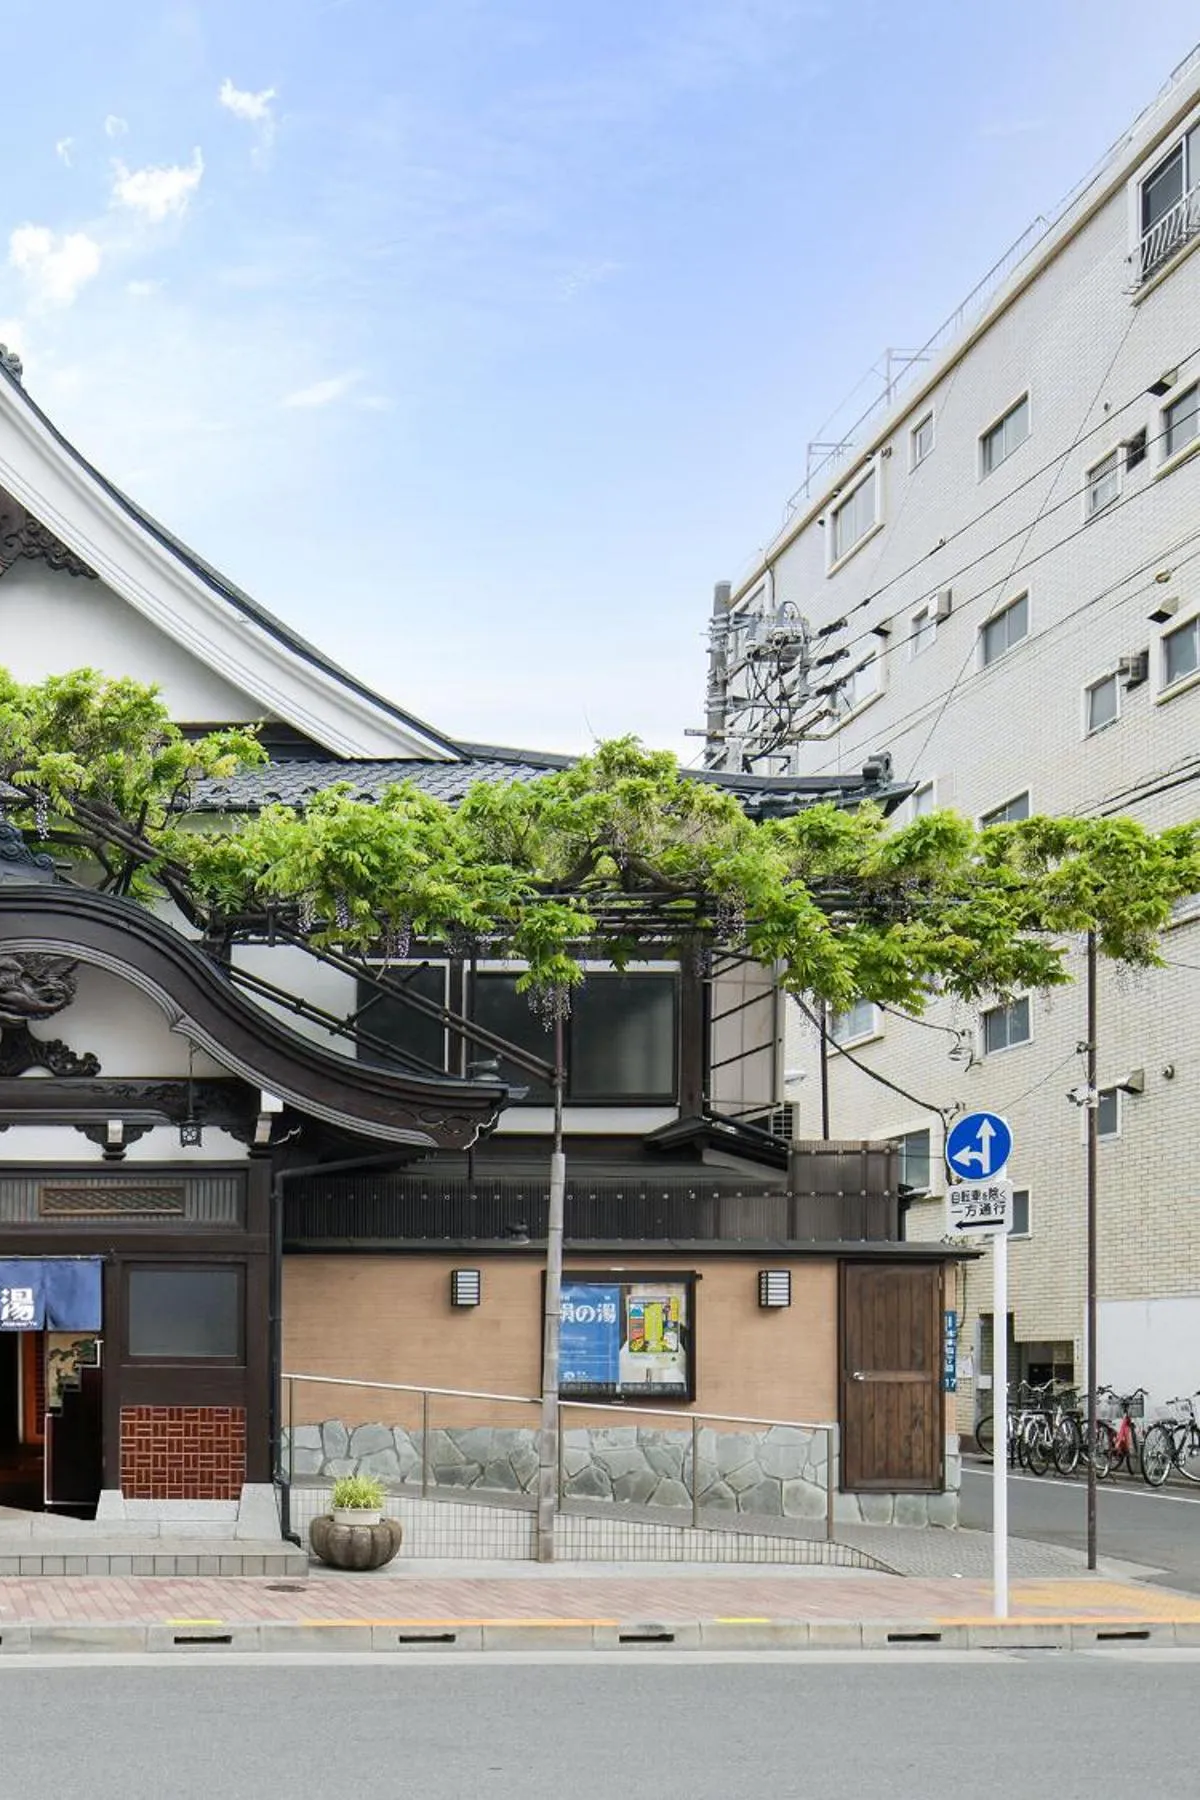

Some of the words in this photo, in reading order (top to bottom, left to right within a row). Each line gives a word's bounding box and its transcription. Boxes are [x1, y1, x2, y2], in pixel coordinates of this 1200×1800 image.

[951, 1187, 1006, 1204] 自転車を除く
[951, 1202, 1006, 1216] 一方通行
[1, 1288, 35, 1320] 湯
